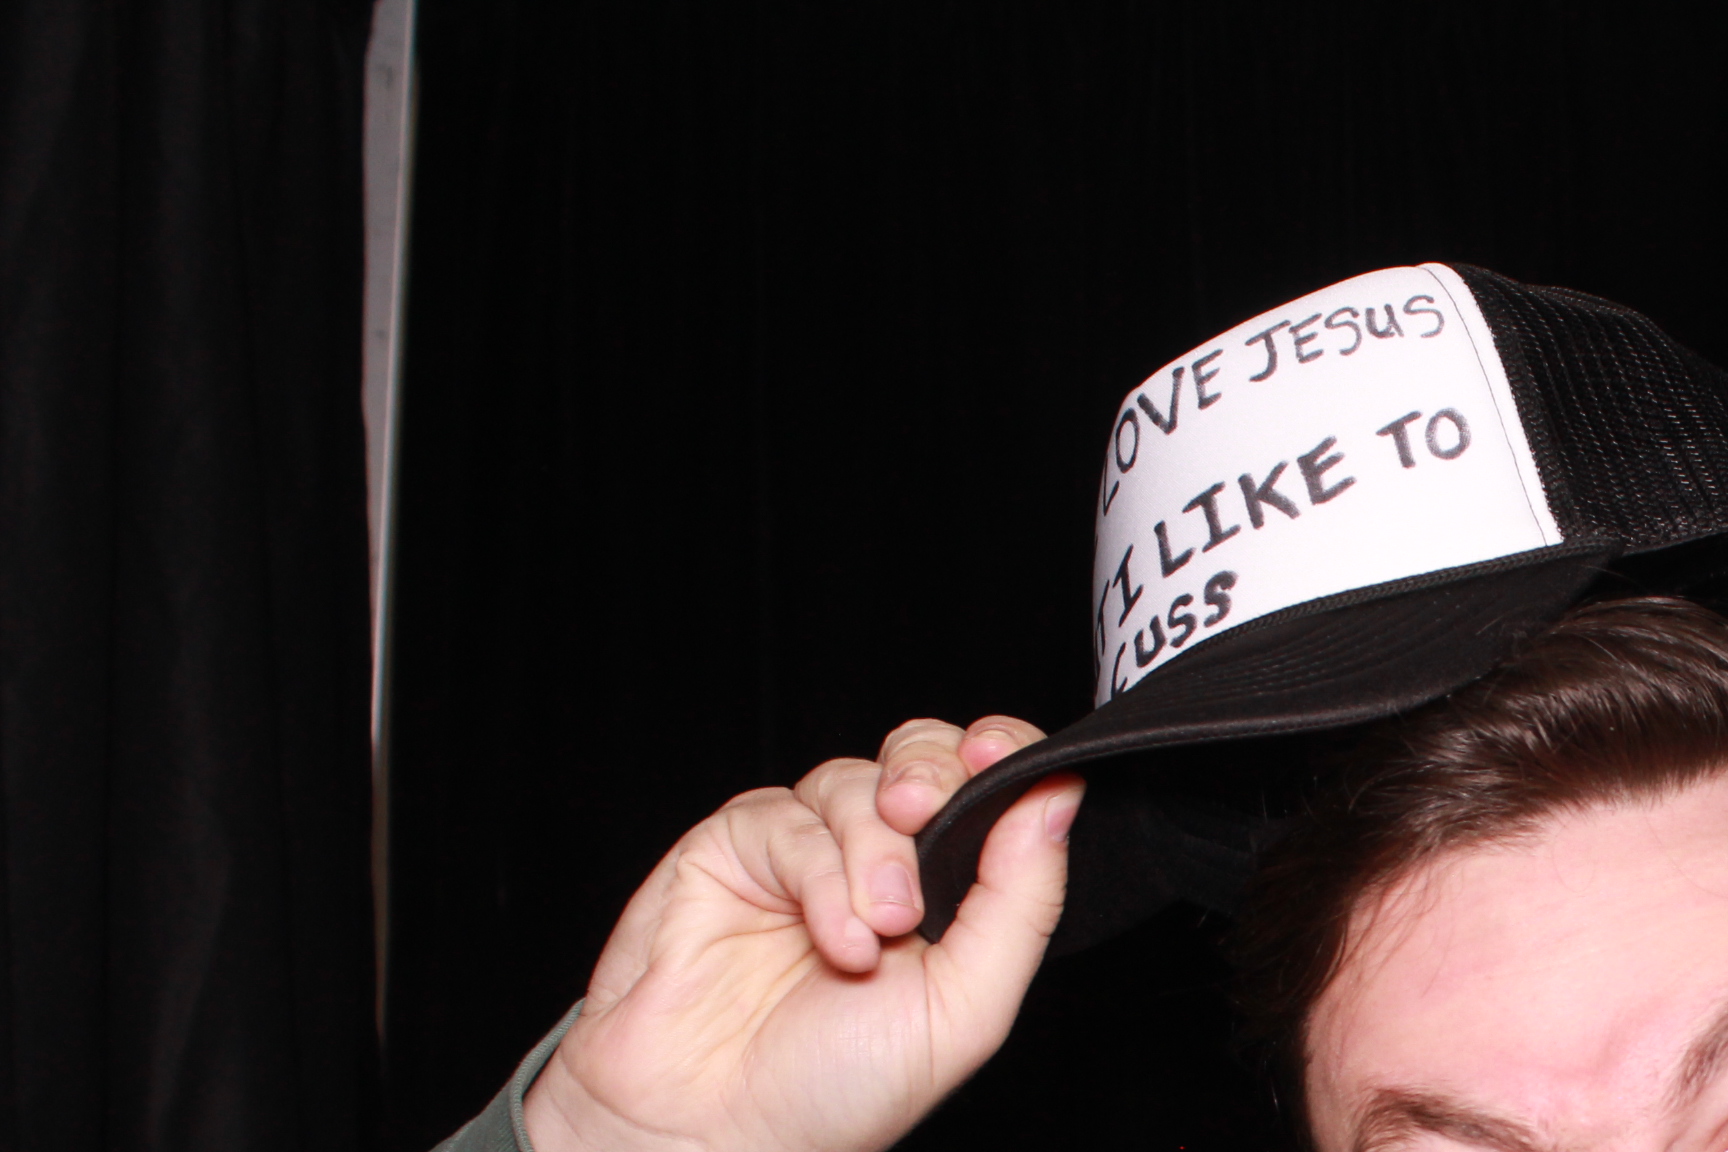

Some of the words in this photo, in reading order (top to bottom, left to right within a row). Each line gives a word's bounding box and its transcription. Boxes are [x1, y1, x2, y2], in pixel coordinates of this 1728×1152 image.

[1102, 349, 1223, 517] LOVE
[1245, 294, 1446, 382] JESUS
[1154, 435, 1357, 577] LIKE
[1376, 408, 1470, 468] TO
